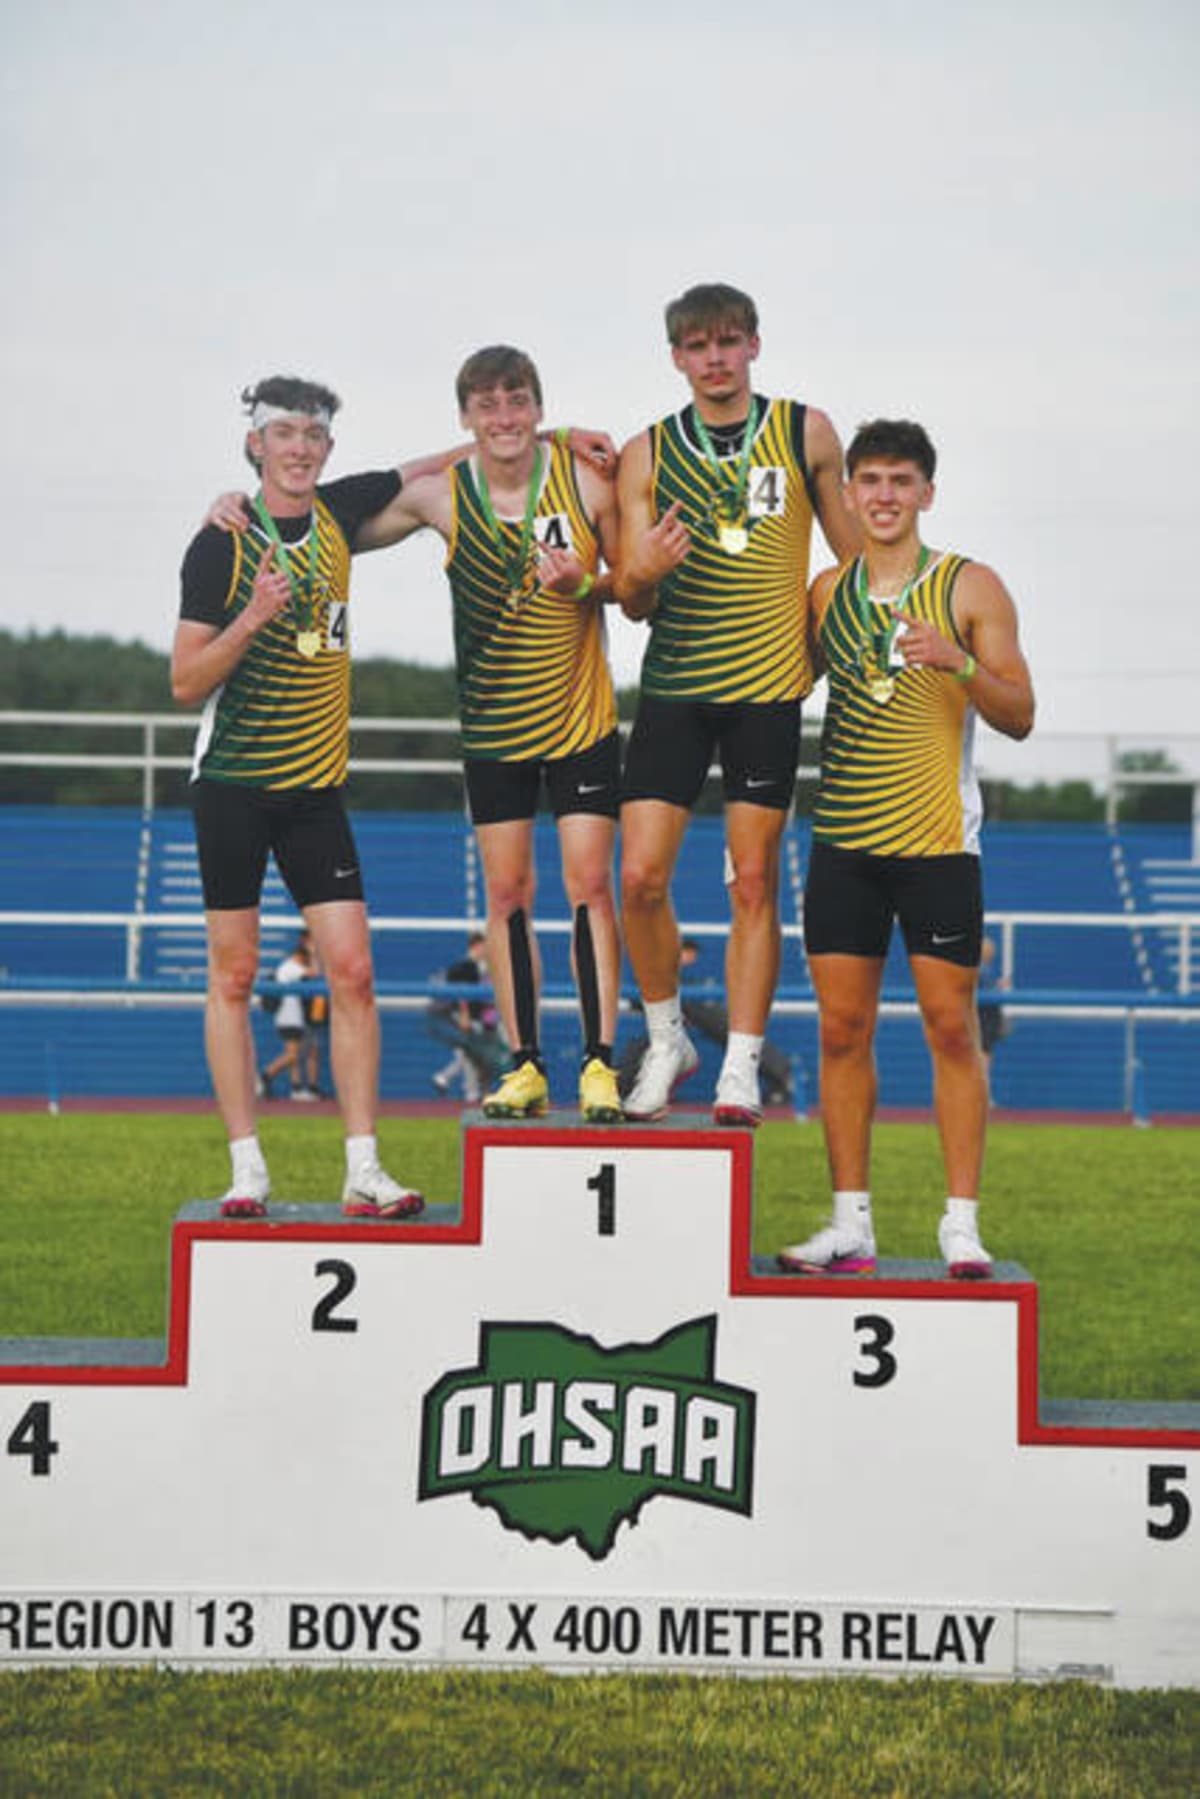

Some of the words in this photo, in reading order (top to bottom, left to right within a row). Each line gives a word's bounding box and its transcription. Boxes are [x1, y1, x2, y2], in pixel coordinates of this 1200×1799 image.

[753, 470, 780, 512] 4
[544, 517, 568, 549] 4
[331, 606, 347, 647] 4
[587, 1164, 616, 1236] 1
[311, 1259, 358, 1333] 2
[852, 1314, 898, 1388] 3
[7, 1401, 59, 1476] 4
[439, 1381, 736, 1490] OHSAA
[1146, 1464, 1192, 1541] 5
[0, 1600, 174, 1650] REGION
[196, 1600, 255, 1649] 13
[288, 1603, 421, 1652] BOYS
[461, 1603, 491, 1651] 4
[506, 1604, 538, 1652] X
[553, 1605, 642, 1655] 400
[658, 1607, 823, 1659] METER
[842, 1612, 996, 1665] RELAY
